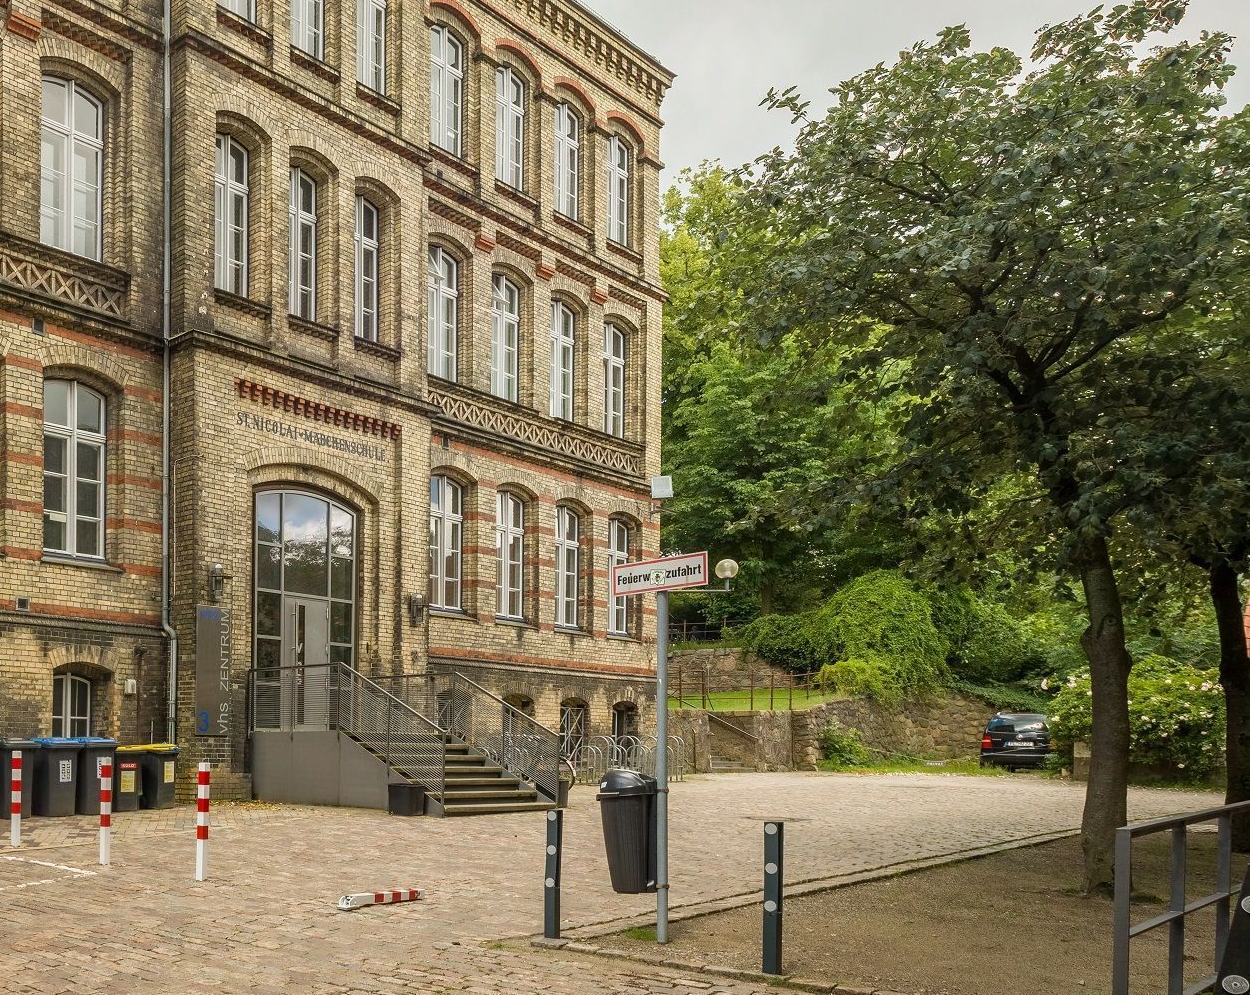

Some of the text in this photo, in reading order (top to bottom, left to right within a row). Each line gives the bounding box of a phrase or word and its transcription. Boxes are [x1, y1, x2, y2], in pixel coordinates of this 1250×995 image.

[617, 563, 702, 585] Feuerwzufahrt
[216, 608, 230, 734] vhs ZENTRUM
[198, 710, 209, 732] 3
